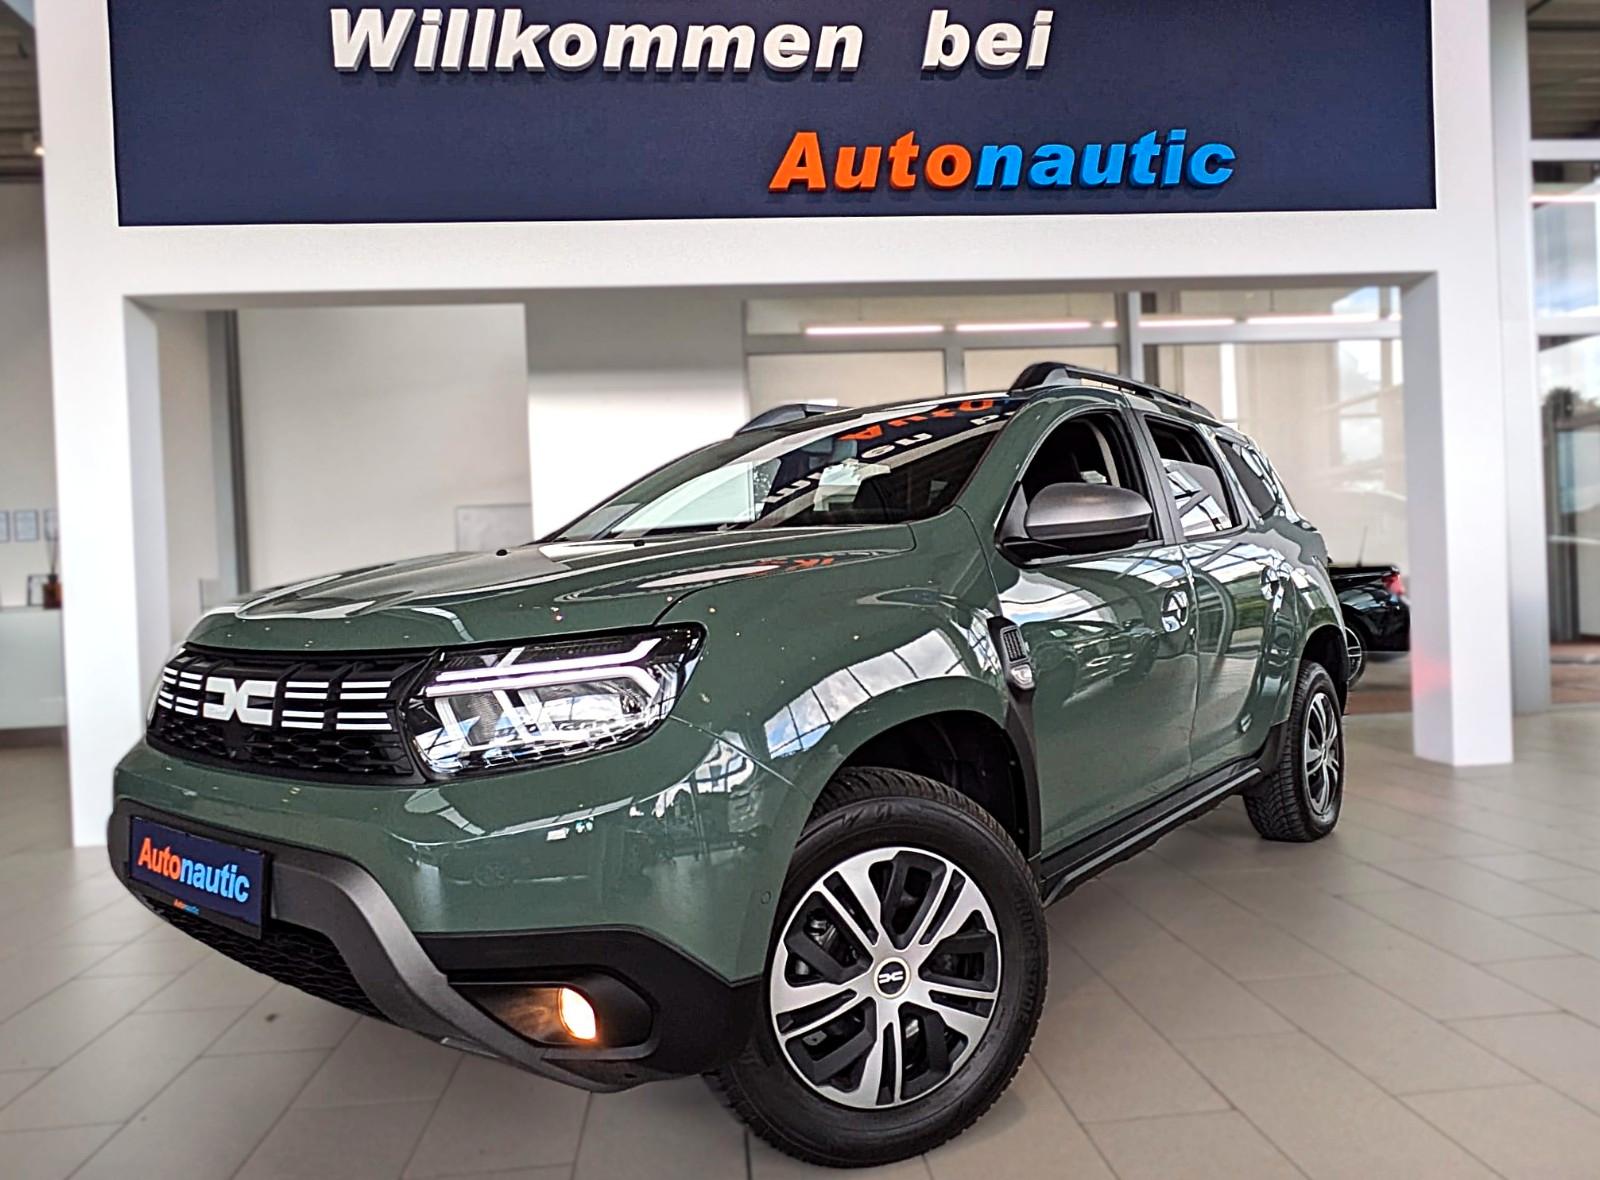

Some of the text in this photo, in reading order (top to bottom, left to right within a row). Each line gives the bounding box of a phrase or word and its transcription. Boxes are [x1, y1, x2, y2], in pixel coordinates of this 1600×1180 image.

[330, 8, 1054, 72] Willkommen bei
[769, 129, 1236, 191] Autonautic
[137, 837, 250, 903] Autonautic
